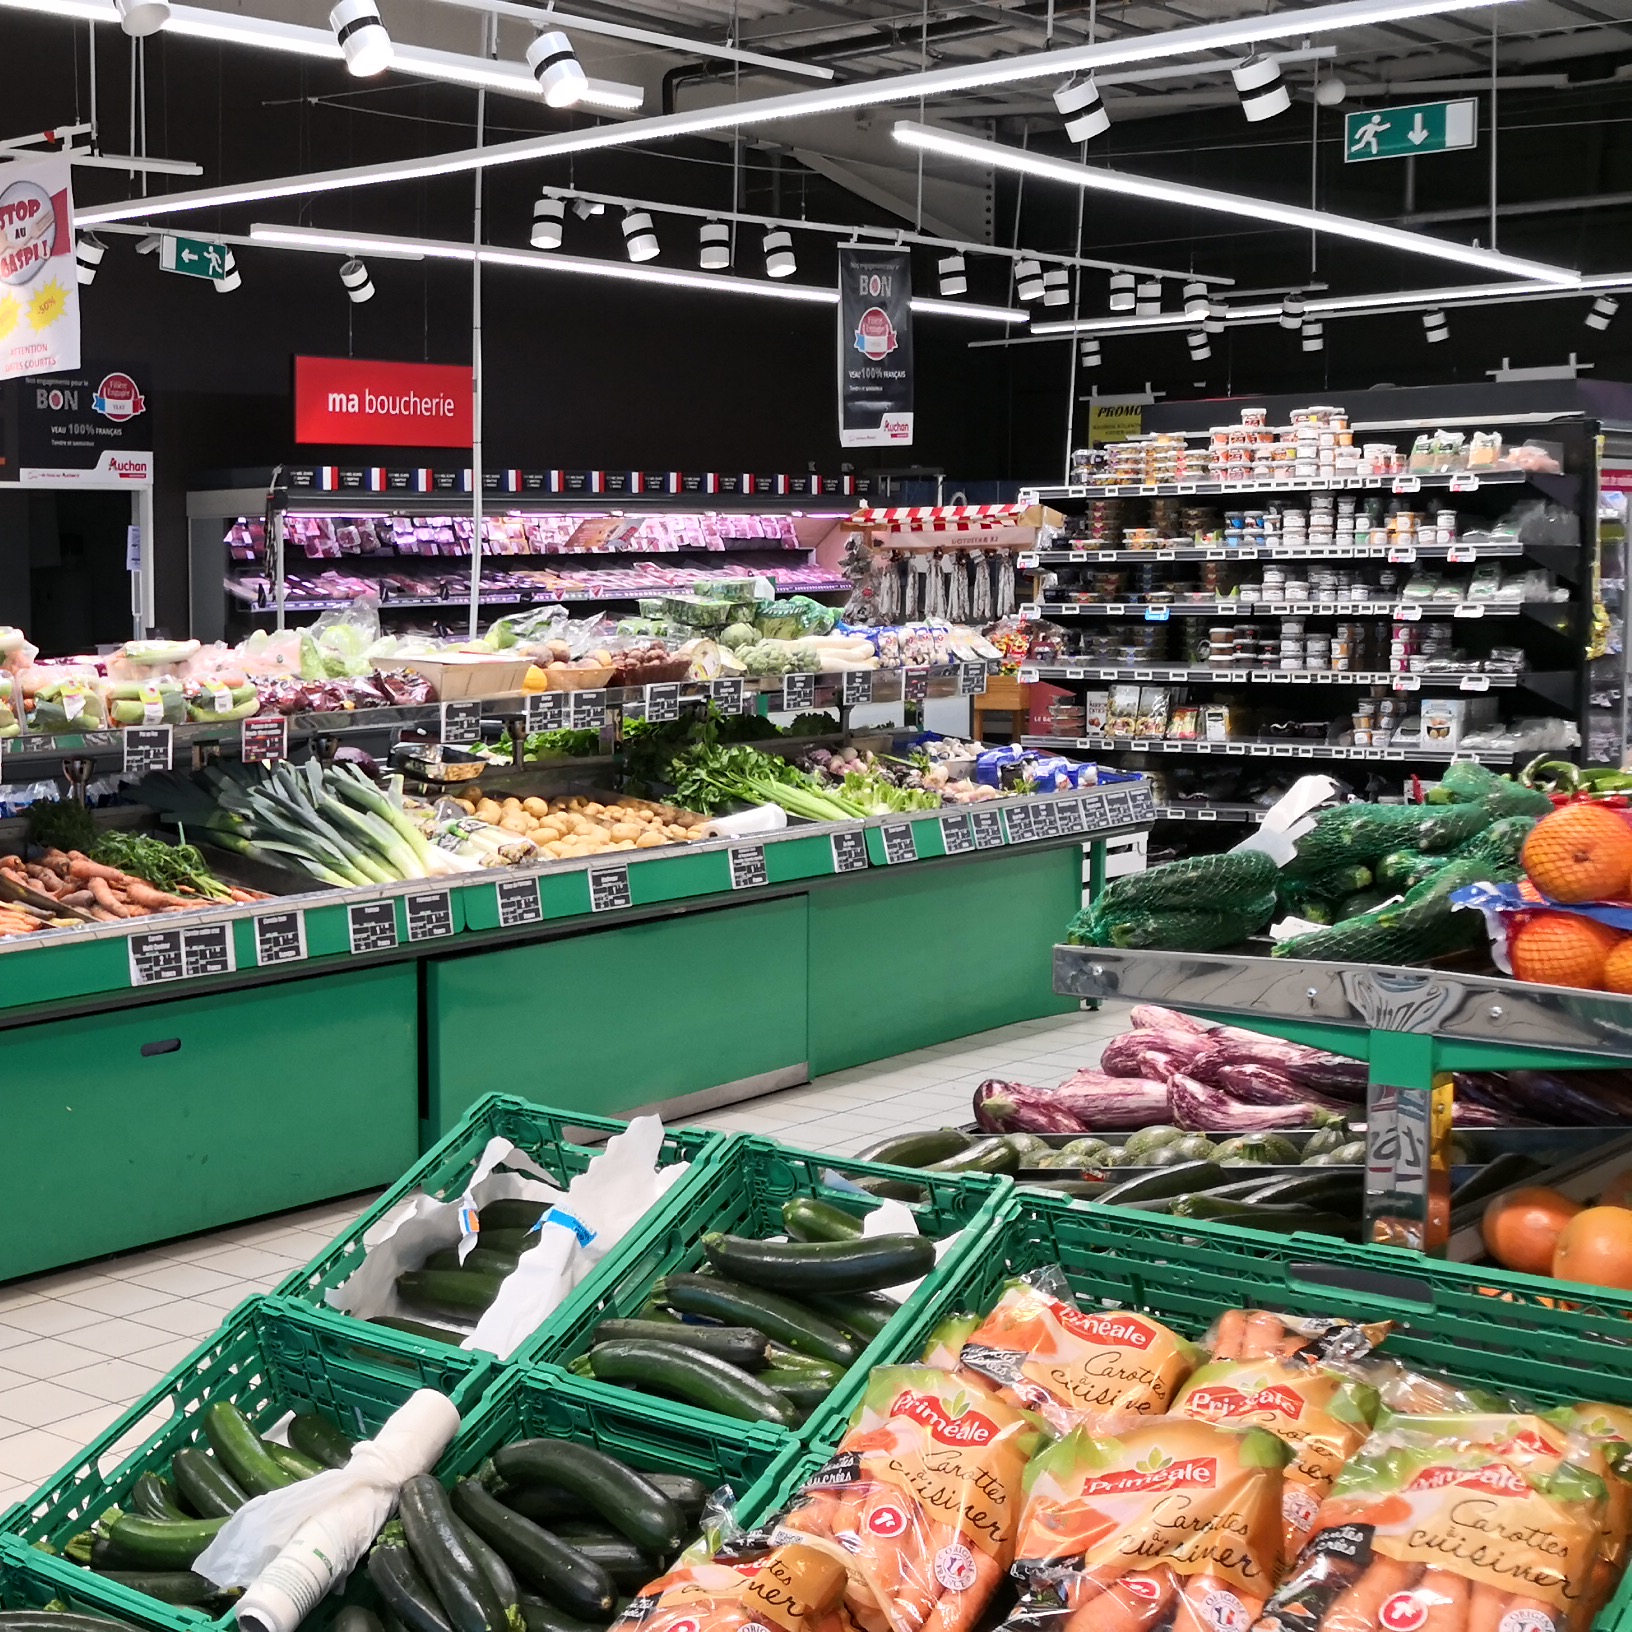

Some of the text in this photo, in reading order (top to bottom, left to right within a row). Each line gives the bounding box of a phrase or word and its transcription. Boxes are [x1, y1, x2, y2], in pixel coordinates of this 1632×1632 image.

[14, 226, 26, 240] AU
[859, 273, 892, 298] BON
[10, 343, 49, 357] ATTENTION
[24, 356, 57, 371] COURTES
[36, 388, 79, 411] BON
[327, 387, 455, 418] ma boucherie
[50, 423, 123, 438] VEAU 100% FRANÇAIS
[883, 419, 910, 434] Auchan
[108, 457, 147, 472] Auchan
[1084, 1350, 1166, 1400] Carottes
[922, 1449, 1008, 1506] Carottes
[1088, 1460, 1211, 1493] Priméale
[888, 1458, 1009, 1545] cuisiner
[1151, 1494, 1249, 1537] Carottes
[1449, 1499, 1569, 1558] Carottes
[1121, 1534, 1264, 1579] cuisiner
[1408, 1529, 1581, 1600] cuisiner
